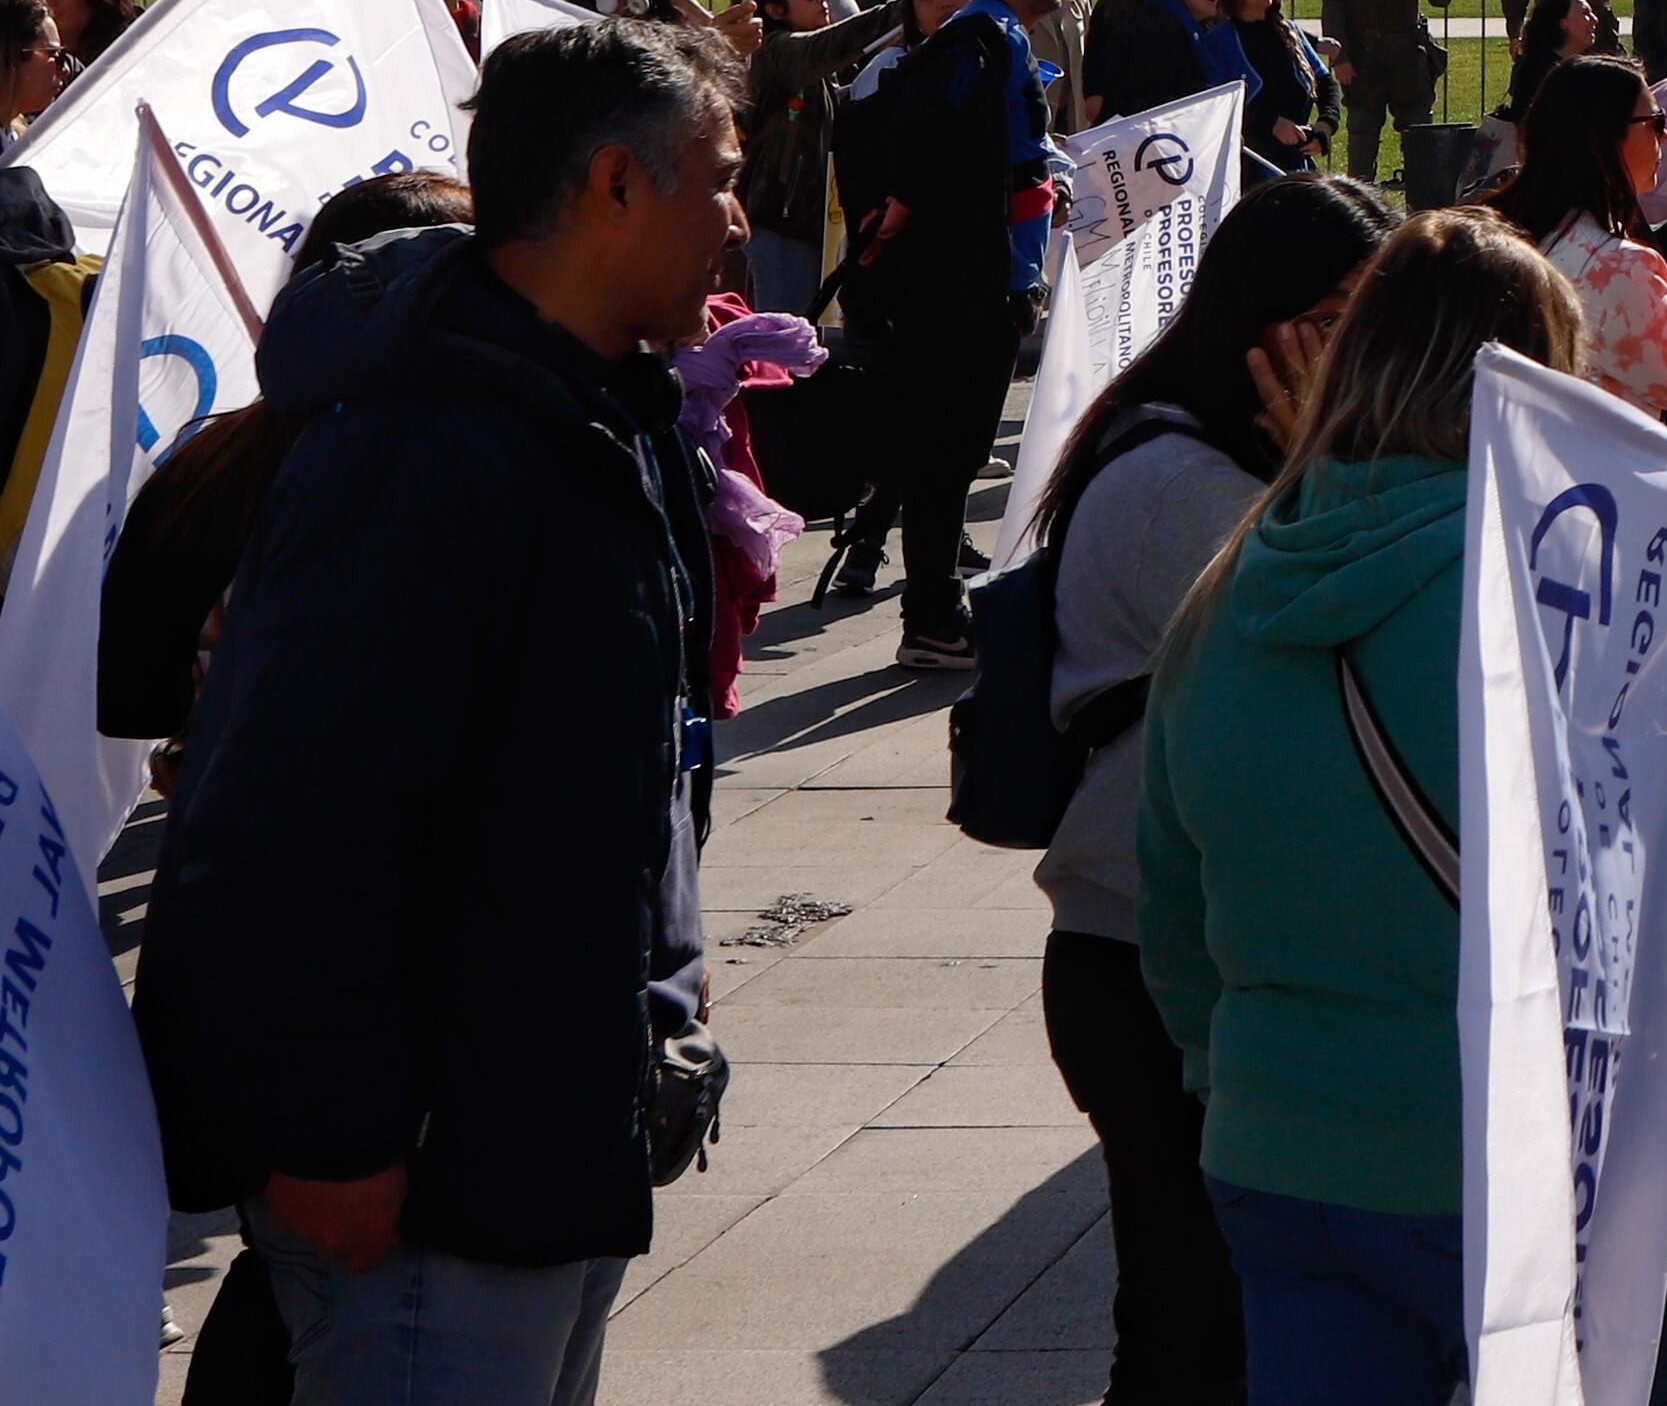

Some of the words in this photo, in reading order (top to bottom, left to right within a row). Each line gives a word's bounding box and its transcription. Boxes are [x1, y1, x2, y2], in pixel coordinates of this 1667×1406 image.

[169, 139, 305, 254] EGIONA
[1102, 149, 1137, 239] REGIONAL
[1142, 233, 1152, 271] CHILE
[1157, 203, 1175, 326] PROFESORE
[1177, 199, 1196, 296] PROFESO
[1117, 241, 1136, 370] METROPOLITANO
